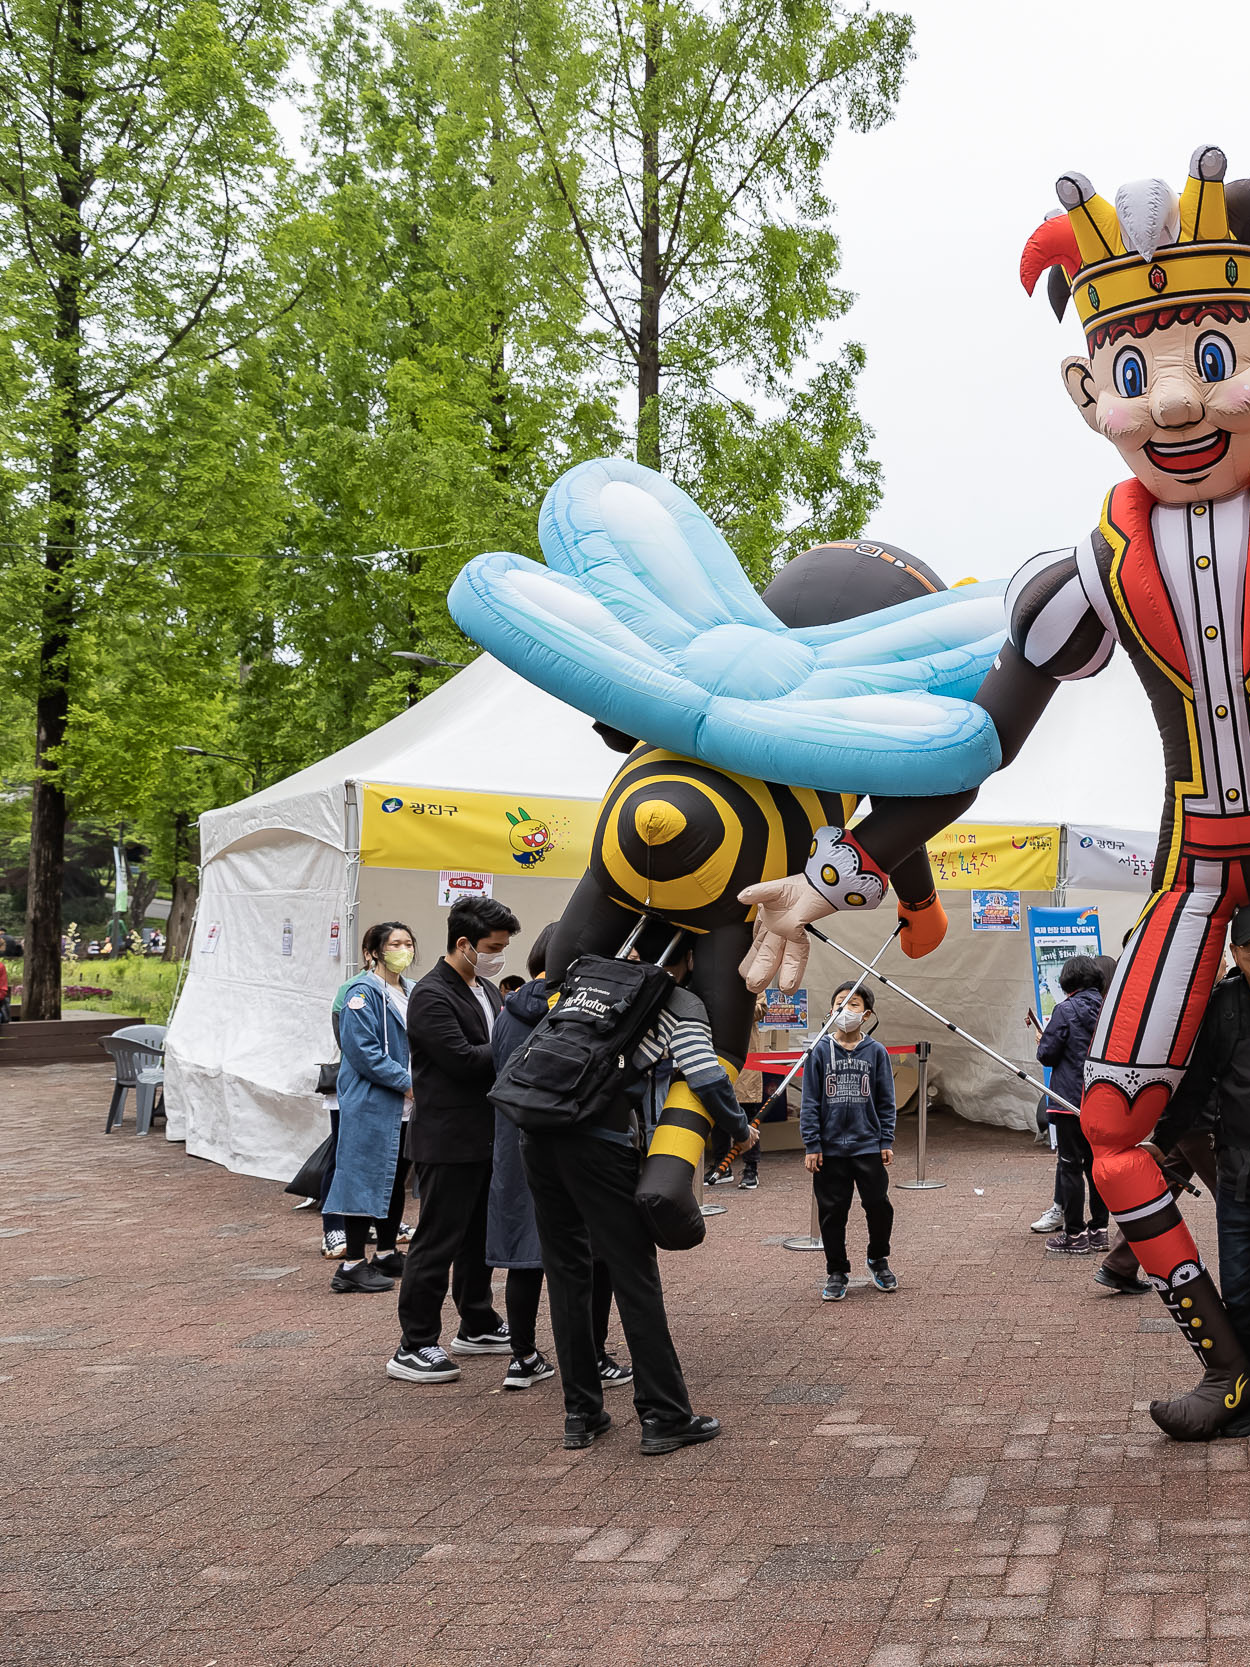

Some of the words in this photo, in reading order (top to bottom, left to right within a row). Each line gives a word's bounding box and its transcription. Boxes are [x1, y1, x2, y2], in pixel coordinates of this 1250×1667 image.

[409, 802, 459, 816] 광진구
[944, 834, 976, 844] 제10회
[1096, 840, 1126, 850] 광진구
[1072, 926, 1096, 934] EVENT
[826, 1058, 872, 1075] ATHENTIC
